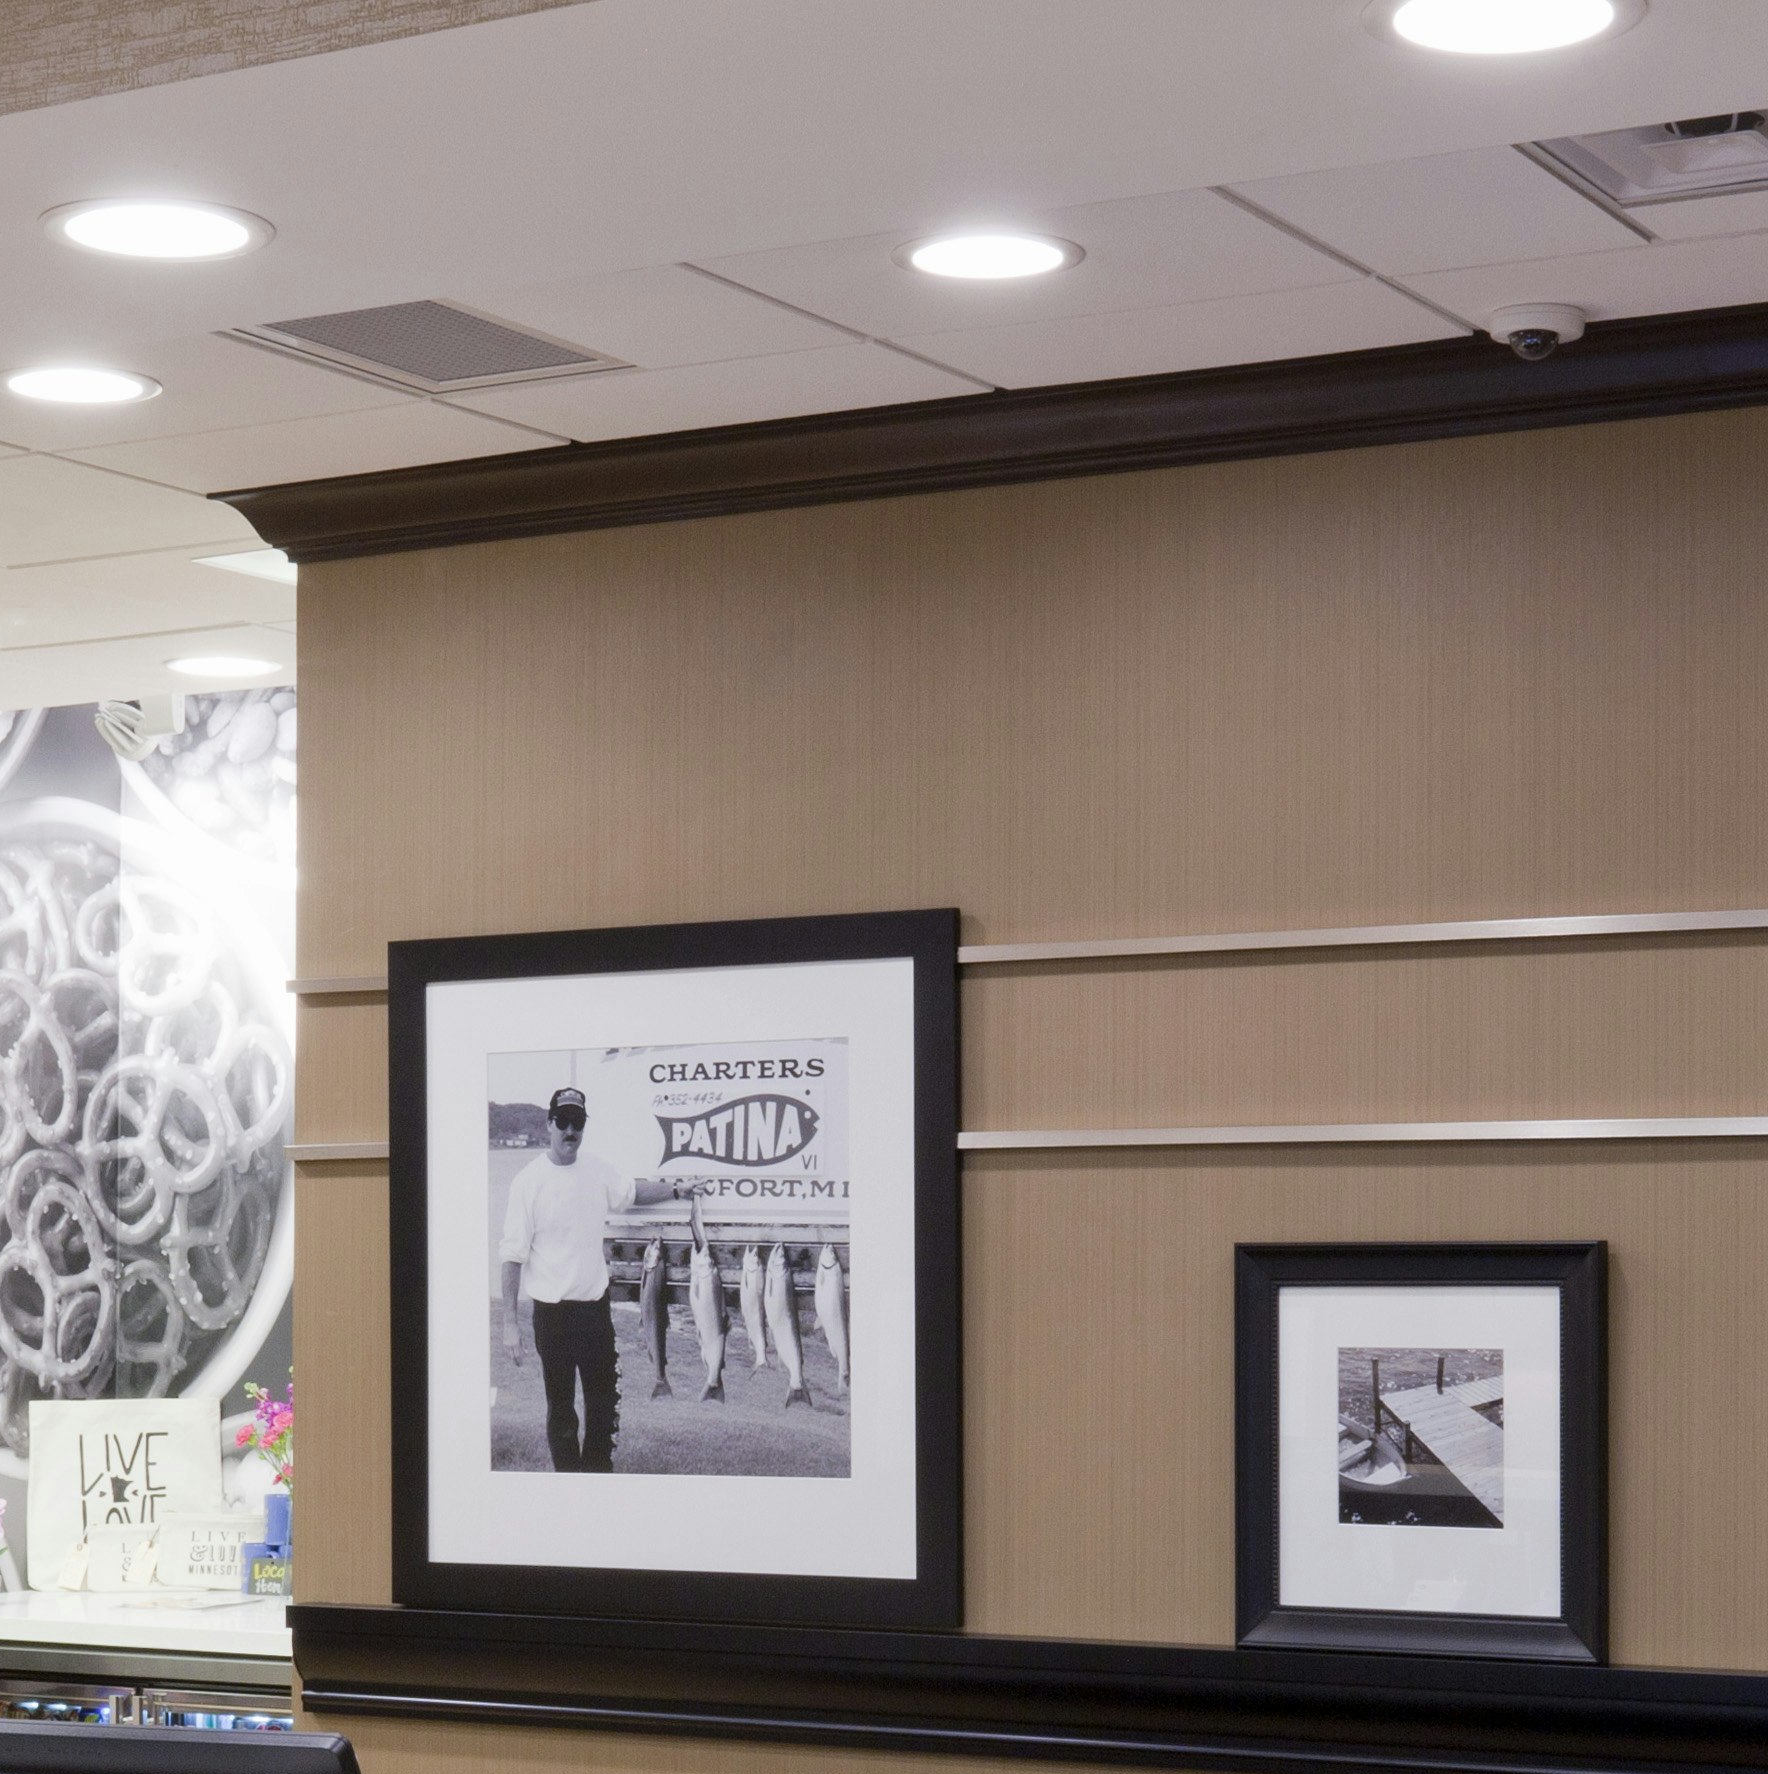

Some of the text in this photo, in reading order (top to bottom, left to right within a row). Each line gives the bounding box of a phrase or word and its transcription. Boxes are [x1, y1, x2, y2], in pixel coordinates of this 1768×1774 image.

[649, 1058, 825, 1083] CHARTERS
[671, 1101, 803, 1161] PATINA
[802, 1154, 818, 1170] VI
[79, 1432, 169, 1496] LIVE
[191, 1530, 248, 1542] LIVE
[188, 1564, 240, 1576] MINNESOT
